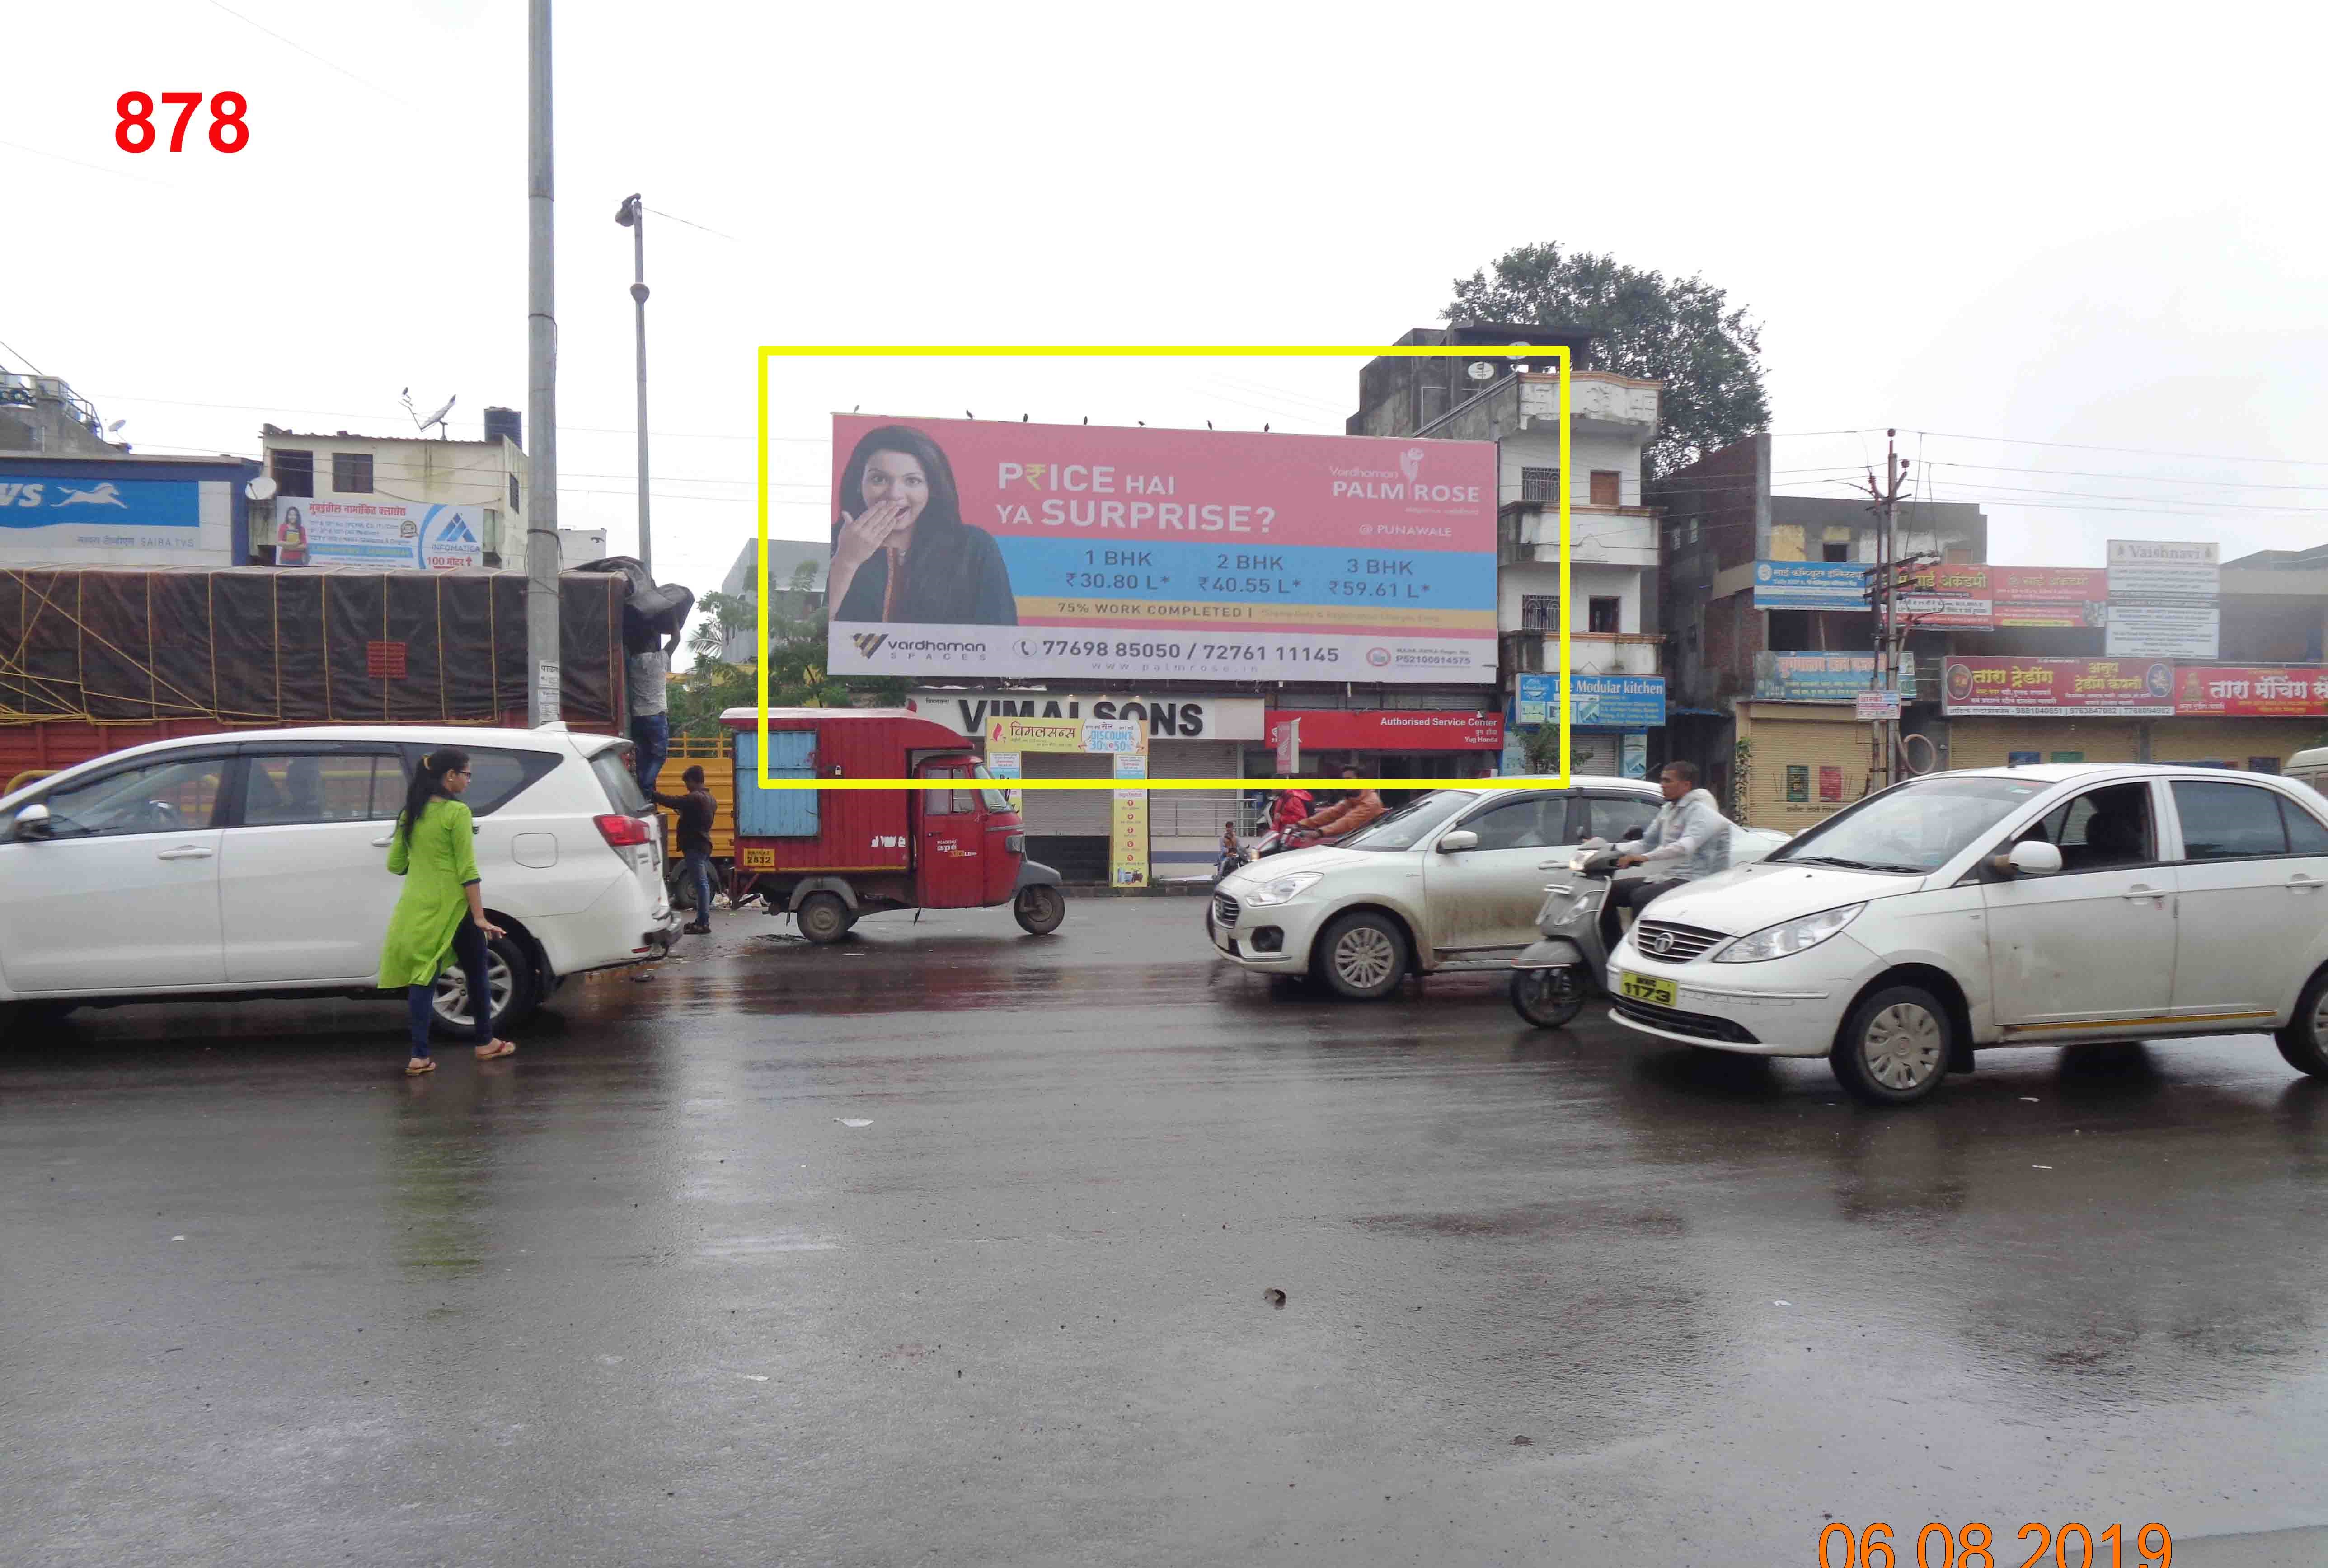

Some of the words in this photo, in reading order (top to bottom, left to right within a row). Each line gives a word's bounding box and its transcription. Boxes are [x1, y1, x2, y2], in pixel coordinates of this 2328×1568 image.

[1126, 475, 1175, 495] HAI
[1332, 480, 1405, 500] PALM
[1413, 483, 1480, 503] ROSE
[996, 504, 1033, 525] YA
[1041, 499, 1276, 534] SURPRISE?
[1377, 524, 1453, 537] PUNAWALE
[1085, 550, 1094, 566] 1
[1104, 551, 1154, 567] BHK
[2129, 545, 2201, 559] Vaishnavi
[427, 556, 445, 566] 100
[1217, 554, 1229, 571] 2
[1236, 555, 1284, 571] BHK
[1347, 558, 1359, 574] 3
[1366, 560, 1414, 576] BHK
[1065, 572, 1138, 590] ₹30.80
[1198, 577, 1271, 594] ₹40.55
[1328, 580, 1398, 598] ₹59.61
[1057, 602, 1089, 613] 75%
[1095, 603, 1141, 615] WORK
[1147, 605, 1242, 618] COMPLETED
[887, 639, 986, 652] vardhaman
[1042, 640, 1109, 657] 77698
[1115, 641, 1181, 659] 85050
[1203, 644, 1266, 661] 72761
[1276, 646, 1339, 663] 11145
[891, 653, 986, 661] SPACES
[1576, 680, 1621, 694] Modular
[1623, 680, 1663, 695] kitchen
[1380, 717, 1431, 726] Authorised
[1432, 718, 1466, 726] Service
[1468, 717, 1497, 727] Center
[1091, 730, 1132, 741] DISCOUNT
